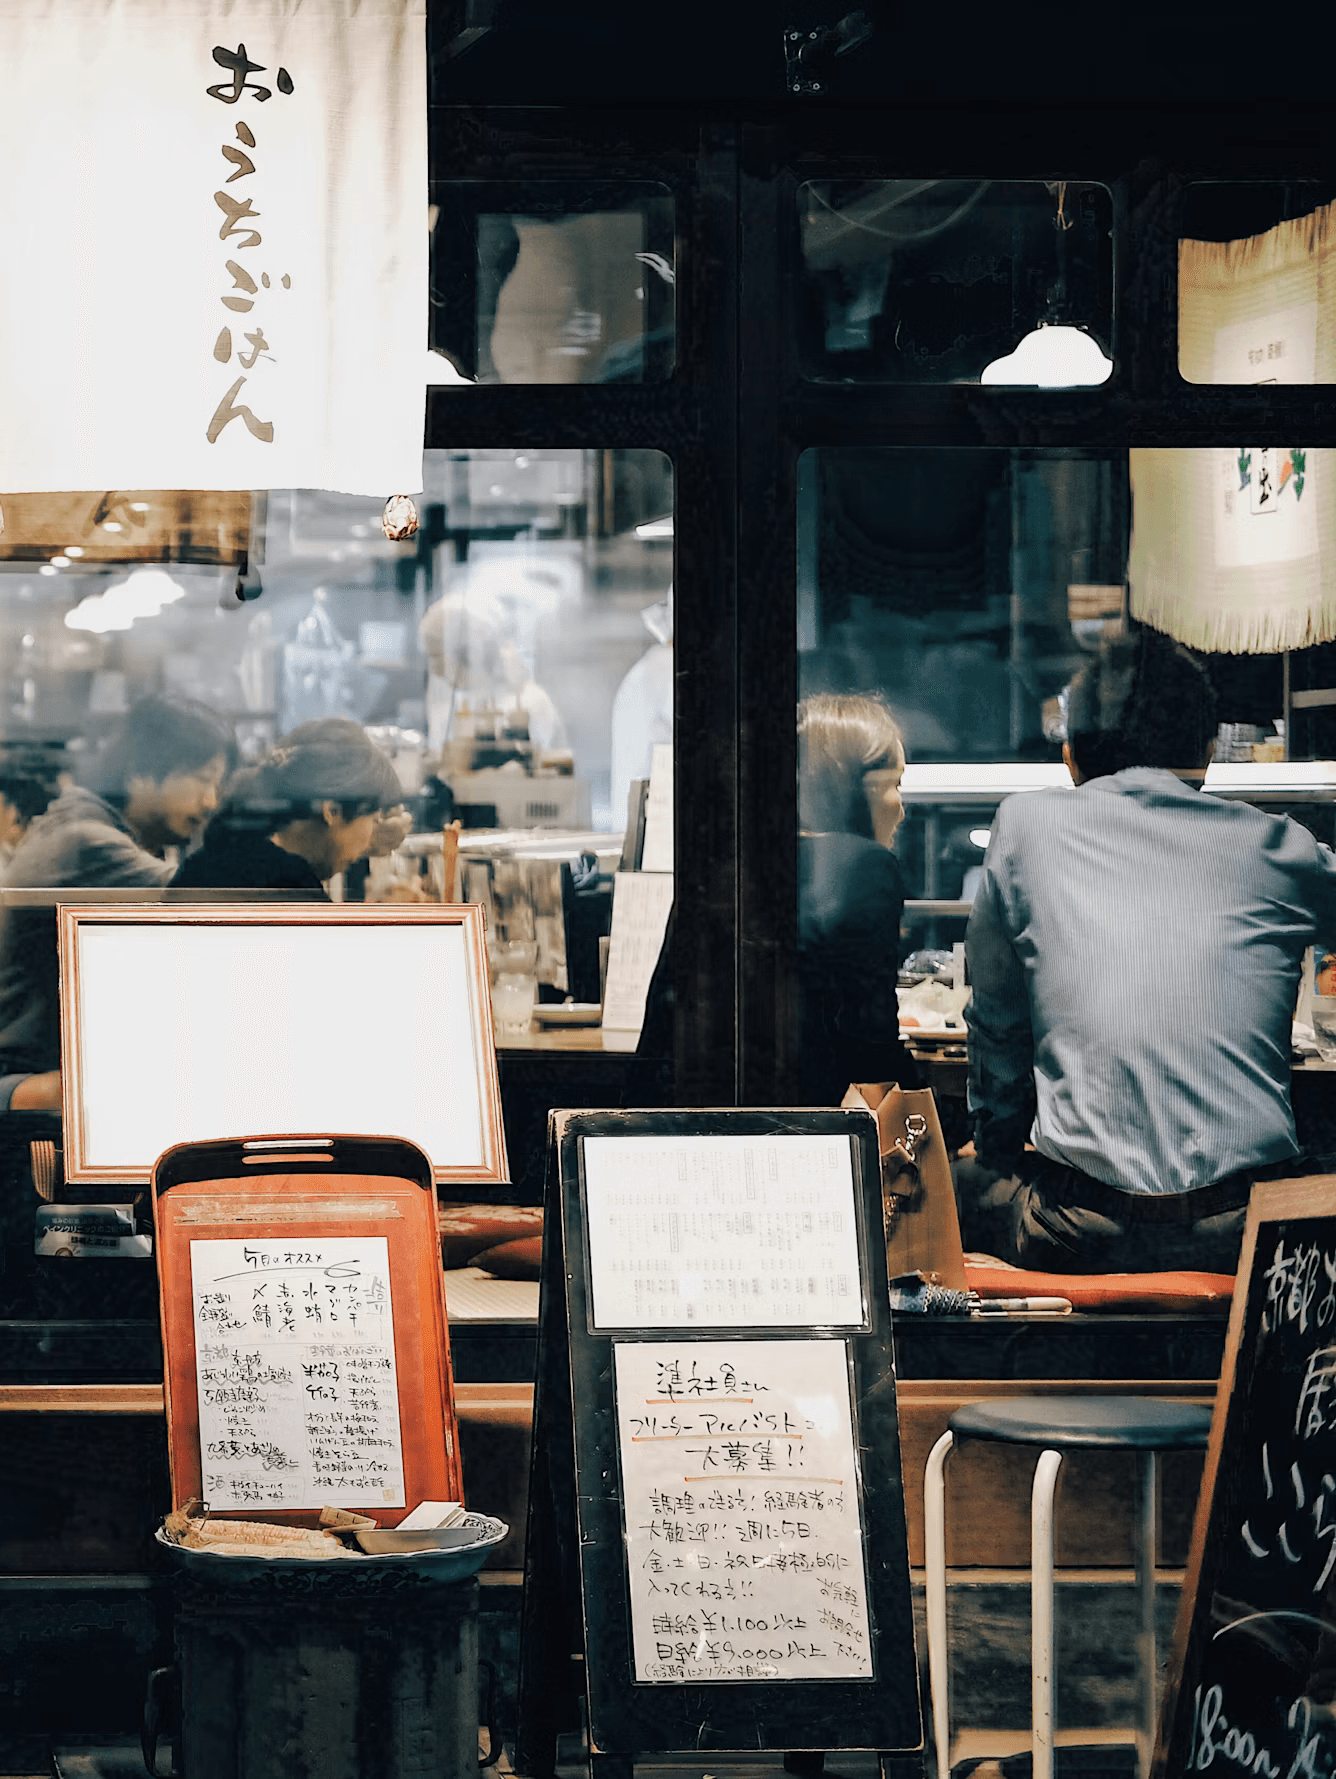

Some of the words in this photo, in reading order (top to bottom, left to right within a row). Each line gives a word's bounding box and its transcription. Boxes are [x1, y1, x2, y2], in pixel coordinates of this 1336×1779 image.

[206, 43, 295, 443] おうちごはん
